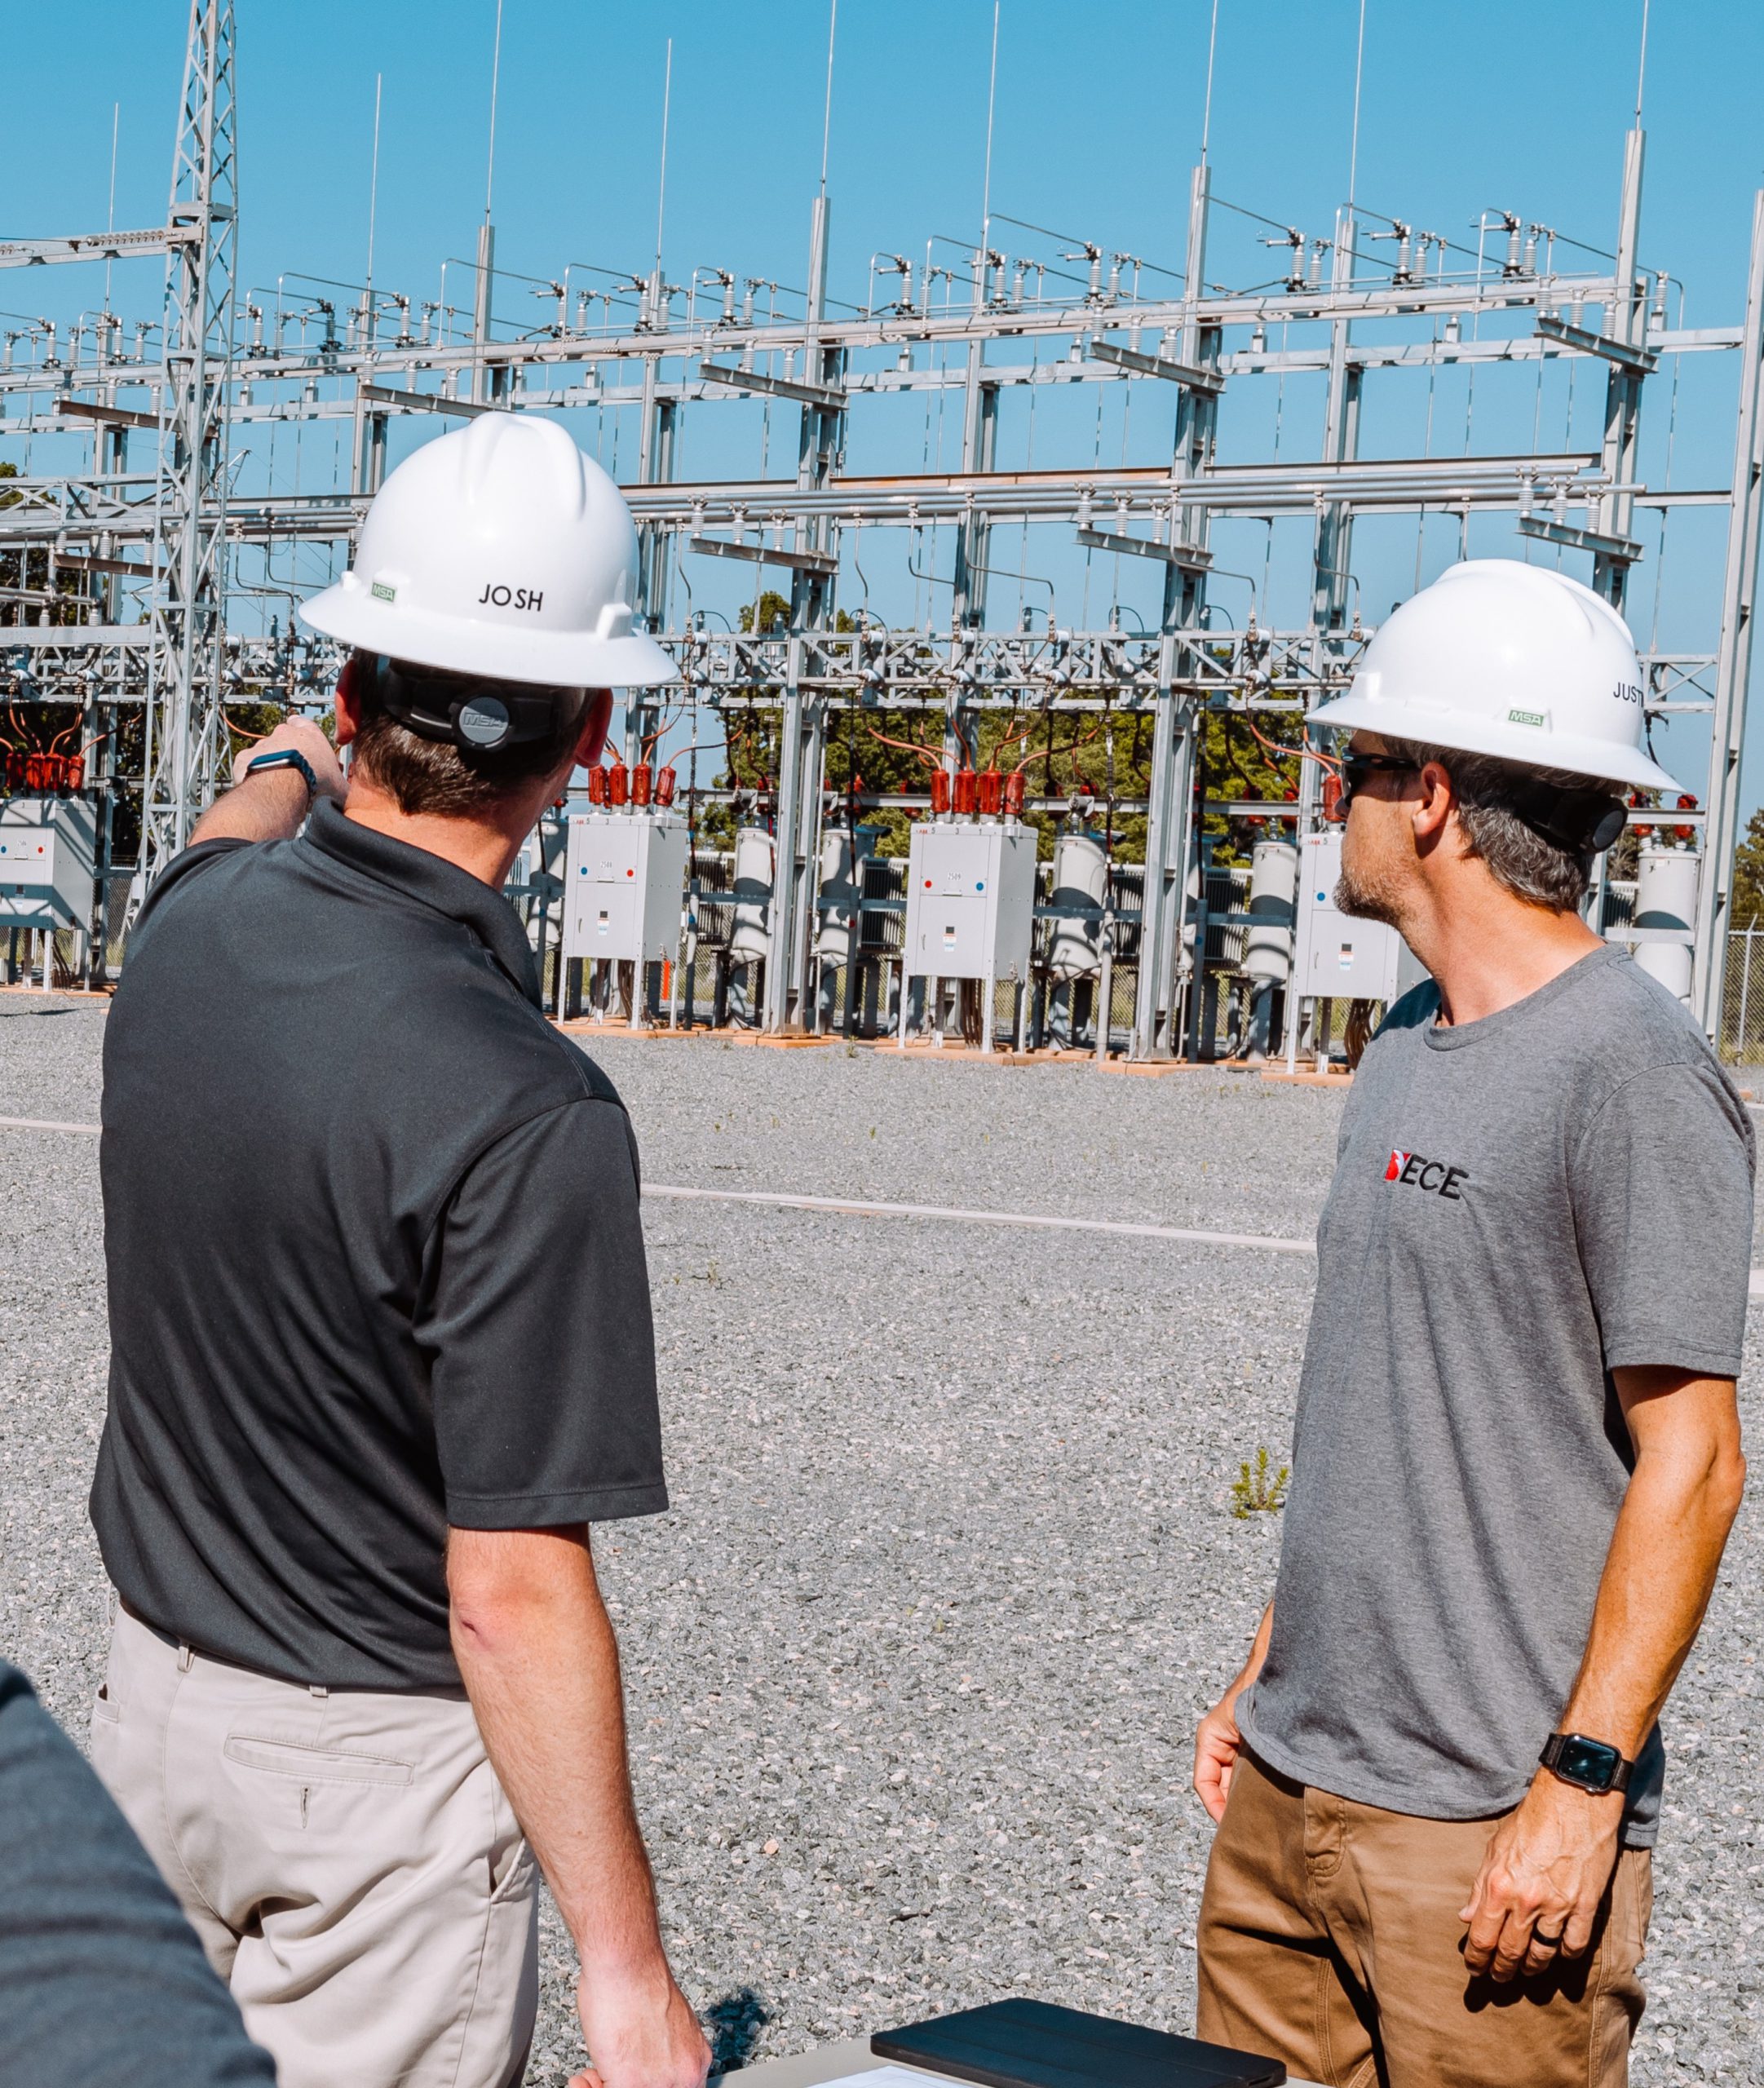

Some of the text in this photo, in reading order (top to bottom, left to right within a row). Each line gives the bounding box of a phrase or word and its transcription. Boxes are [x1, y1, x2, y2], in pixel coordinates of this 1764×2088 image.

[372, 583, 394, 602] MSA
[478, 583, 543, 612] JOSH
[1510, 710, 1542, 726] MSA
[955, 827, 960, 835] 3
[1323, 837, 1329, 846] 5
[1399, 1153, 1470, 1201] ECE
